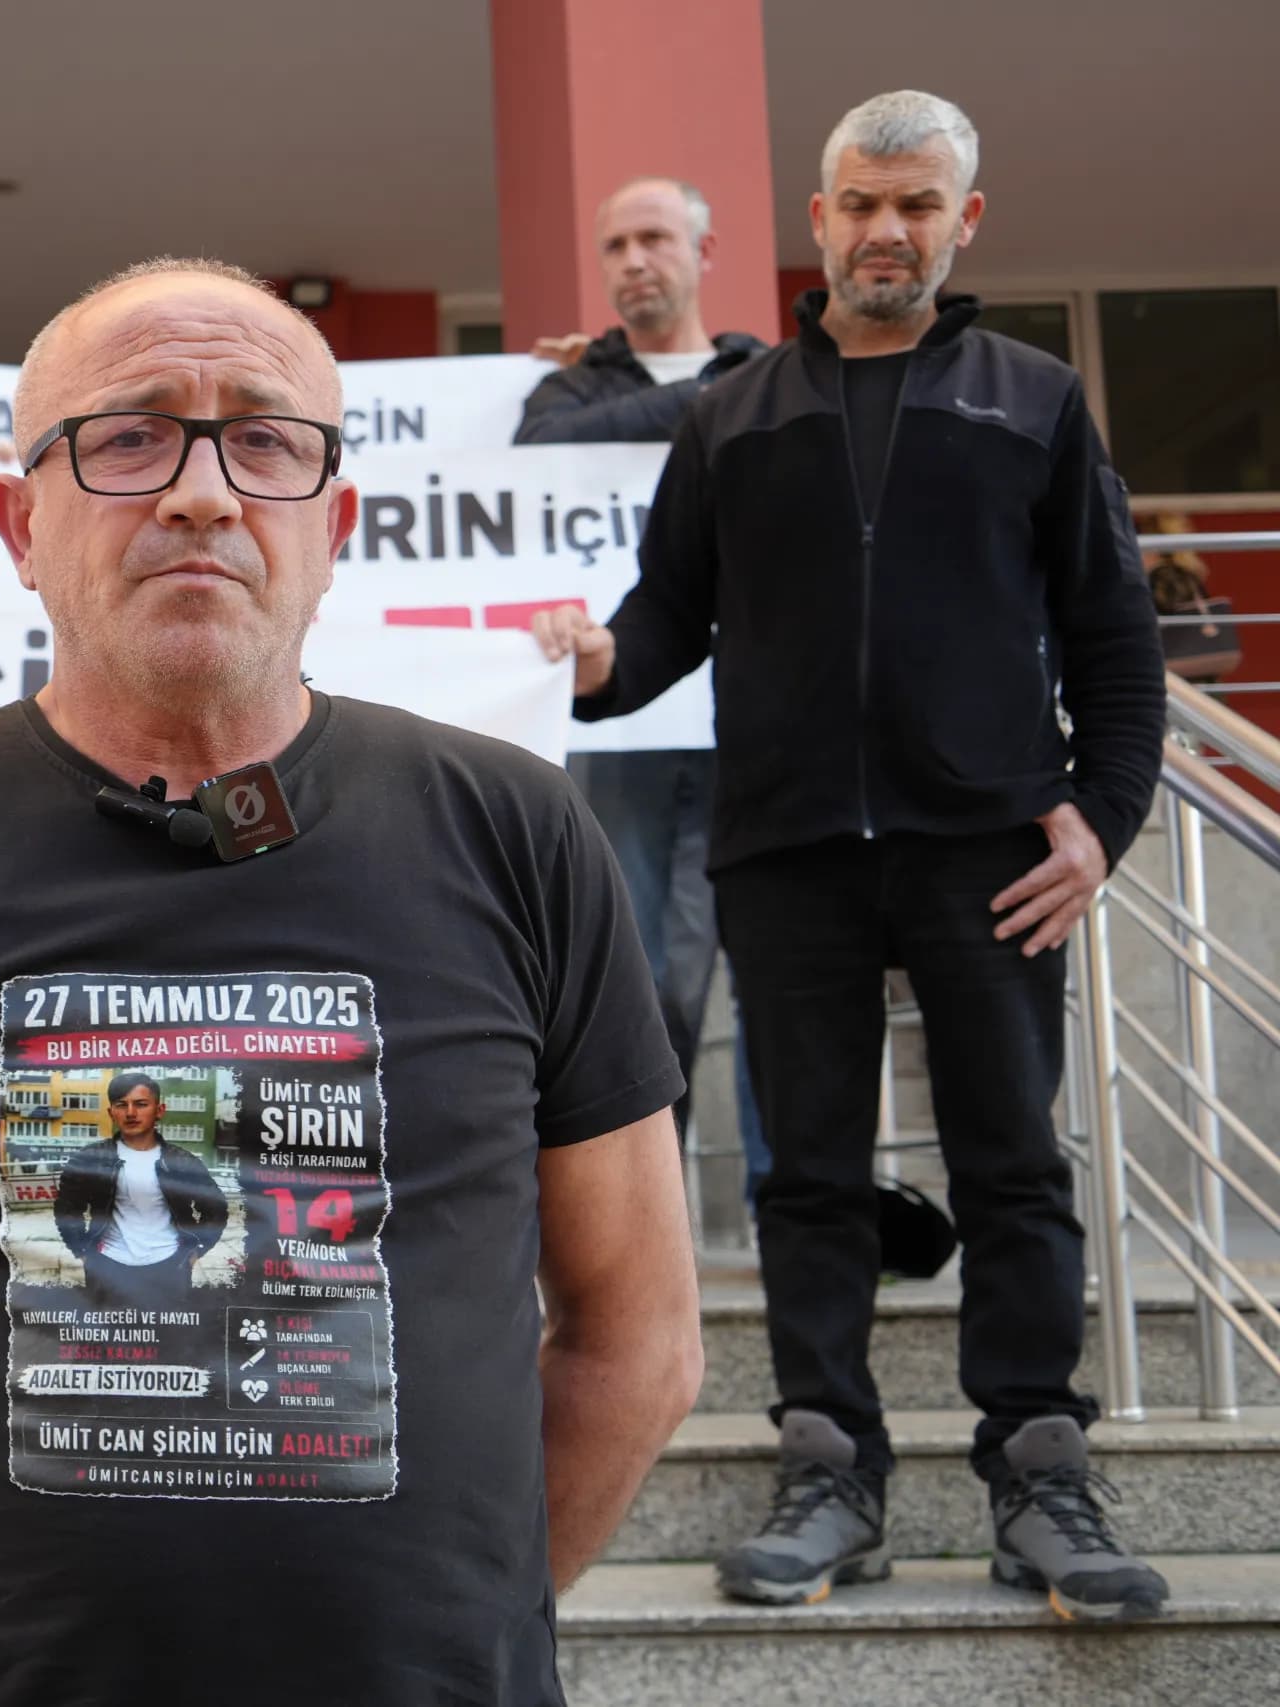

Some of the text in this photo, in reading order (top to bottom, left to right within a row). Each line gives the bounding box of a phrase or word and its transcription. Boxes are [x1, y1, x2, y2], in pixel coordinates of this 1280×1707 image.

[341, 398, 425, 454] ÇİN
[337, 472, 516, 562] RİN
[24, 983, 360, 1028] 27 TEMMUZ 2025
[46, 1031, 337, 1061] BU BİR KAZA DEĞİL, CİNAYET!
[260, 1077, 362, 1105] ÜMİT CAN
[260, 1104, 363, 1151] ŞİRİN
[260, 1151, 367, 1169] 5 KİŞİ TARAFINDAN
[263, 1187, 357, 1242] 14
[277, 1238, 349, 1262] YERİNDEN
[262, 1281, 380, 1301] ÖLÜME TERK EDİLMİŞTİR.
[22, 1308, 200, 1326] HAYALLERİ, GELECEĞİ VE HAYATI
[59, 1326, 160, 1344] ELİNDEN ALINDI.
[276, 1331, 333, 1344] TARAFINDAN
[28, 1366, 200, 1392] ADALET İSTİYORUZ!
[277, 1362, 332, 1376] BIÇAKLANDI
[279, 1394, 335, 1408] TERK EDİLDİ
[39, 1421, 372, 1460] ÜMİT CAN ŞİRİN İÇİN ADALET!
